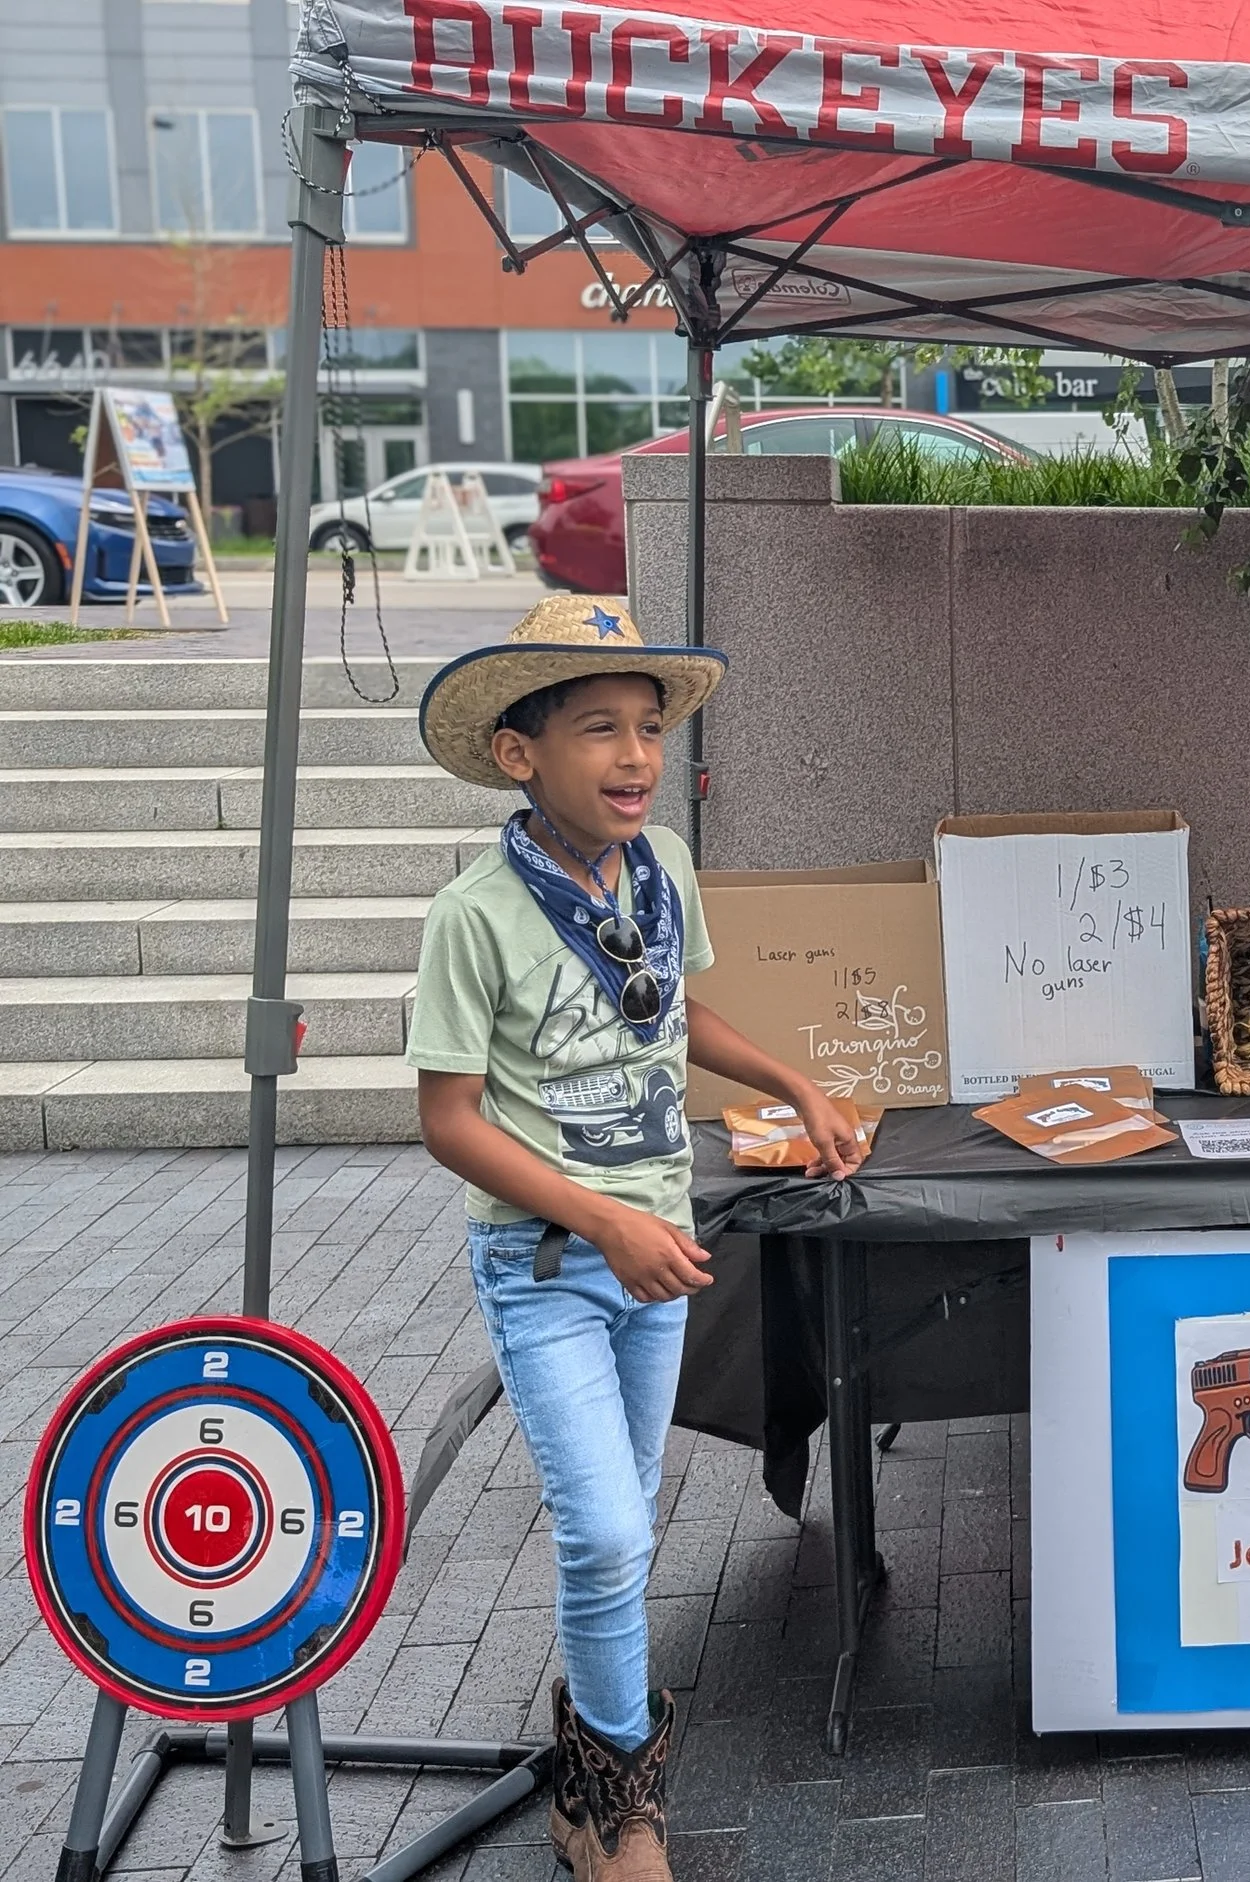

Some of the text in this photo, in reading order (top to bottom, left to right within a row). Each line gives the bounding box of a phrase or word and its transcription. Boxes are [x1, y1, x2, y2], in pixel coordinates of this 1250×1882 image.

[403, 0, 1188, 174] BUCKEYES
[1055, 370, 1099, 398] bar
[1058, 856, 1130, 912] 1/$3
[1079, 899, 1166, 951] 2/$4
[757, 946, 836, 964] Laser guns
[1005, 941, 1112, 983] No laser
[1042, 977, 1084, 1001] guns
[964, 1074, 1009, 1085] BOTTLED
[202, 1351, 230, 1378] 2
[199, 1418, 225, 1445] 6
[55, 1499, 365, 1538] 2 6 10 6 2
[188, 1600, 215, 1627] 6
[184, 1658, 211, 1686] 2
